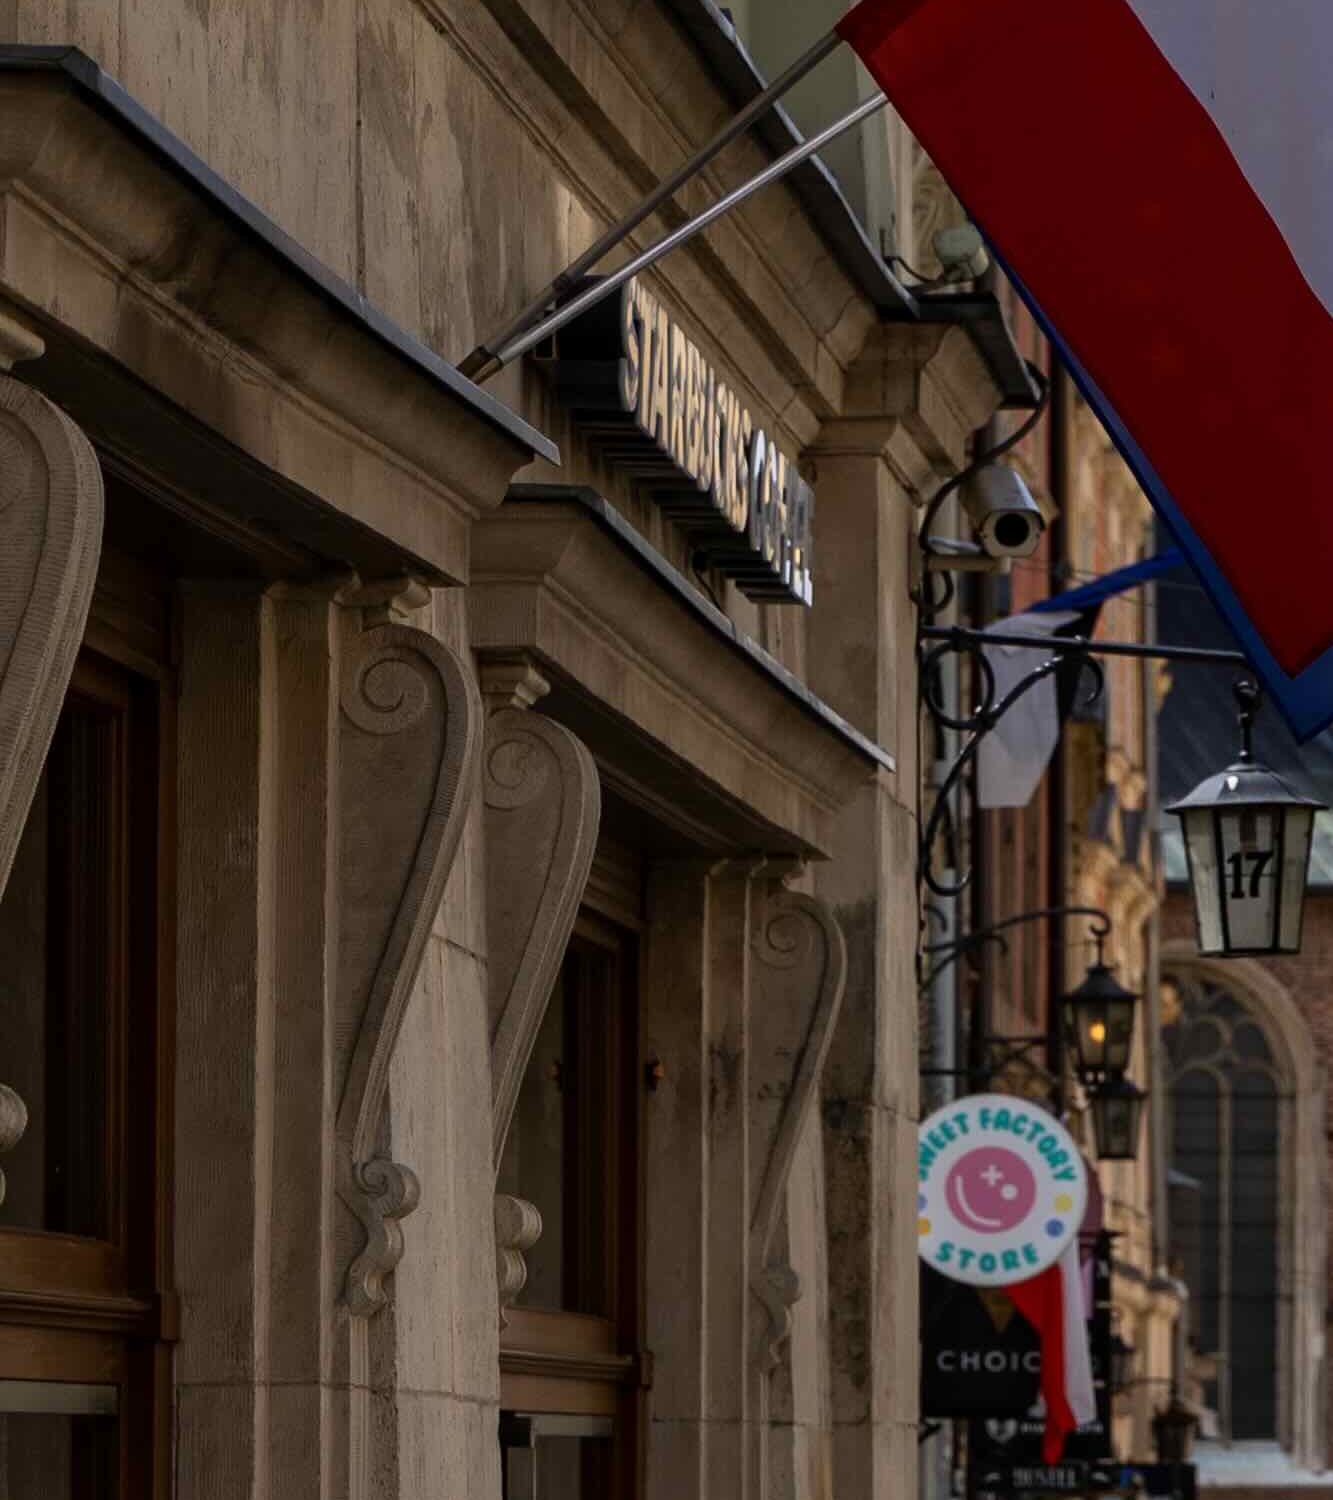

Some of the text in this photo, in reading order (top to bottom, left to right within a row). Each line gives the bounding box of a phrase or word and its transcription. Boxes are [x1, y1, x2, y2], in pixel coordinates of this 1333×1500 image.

[624, 276, 752, 534] STARBUCKS
[1227, 850, 1274, 899] 17
[979, 1107, 1077, 1182] FACTORY
[936, 1241, 1039, 1274] STORE
[936, 1351, 1042, 1373] CHOIC
